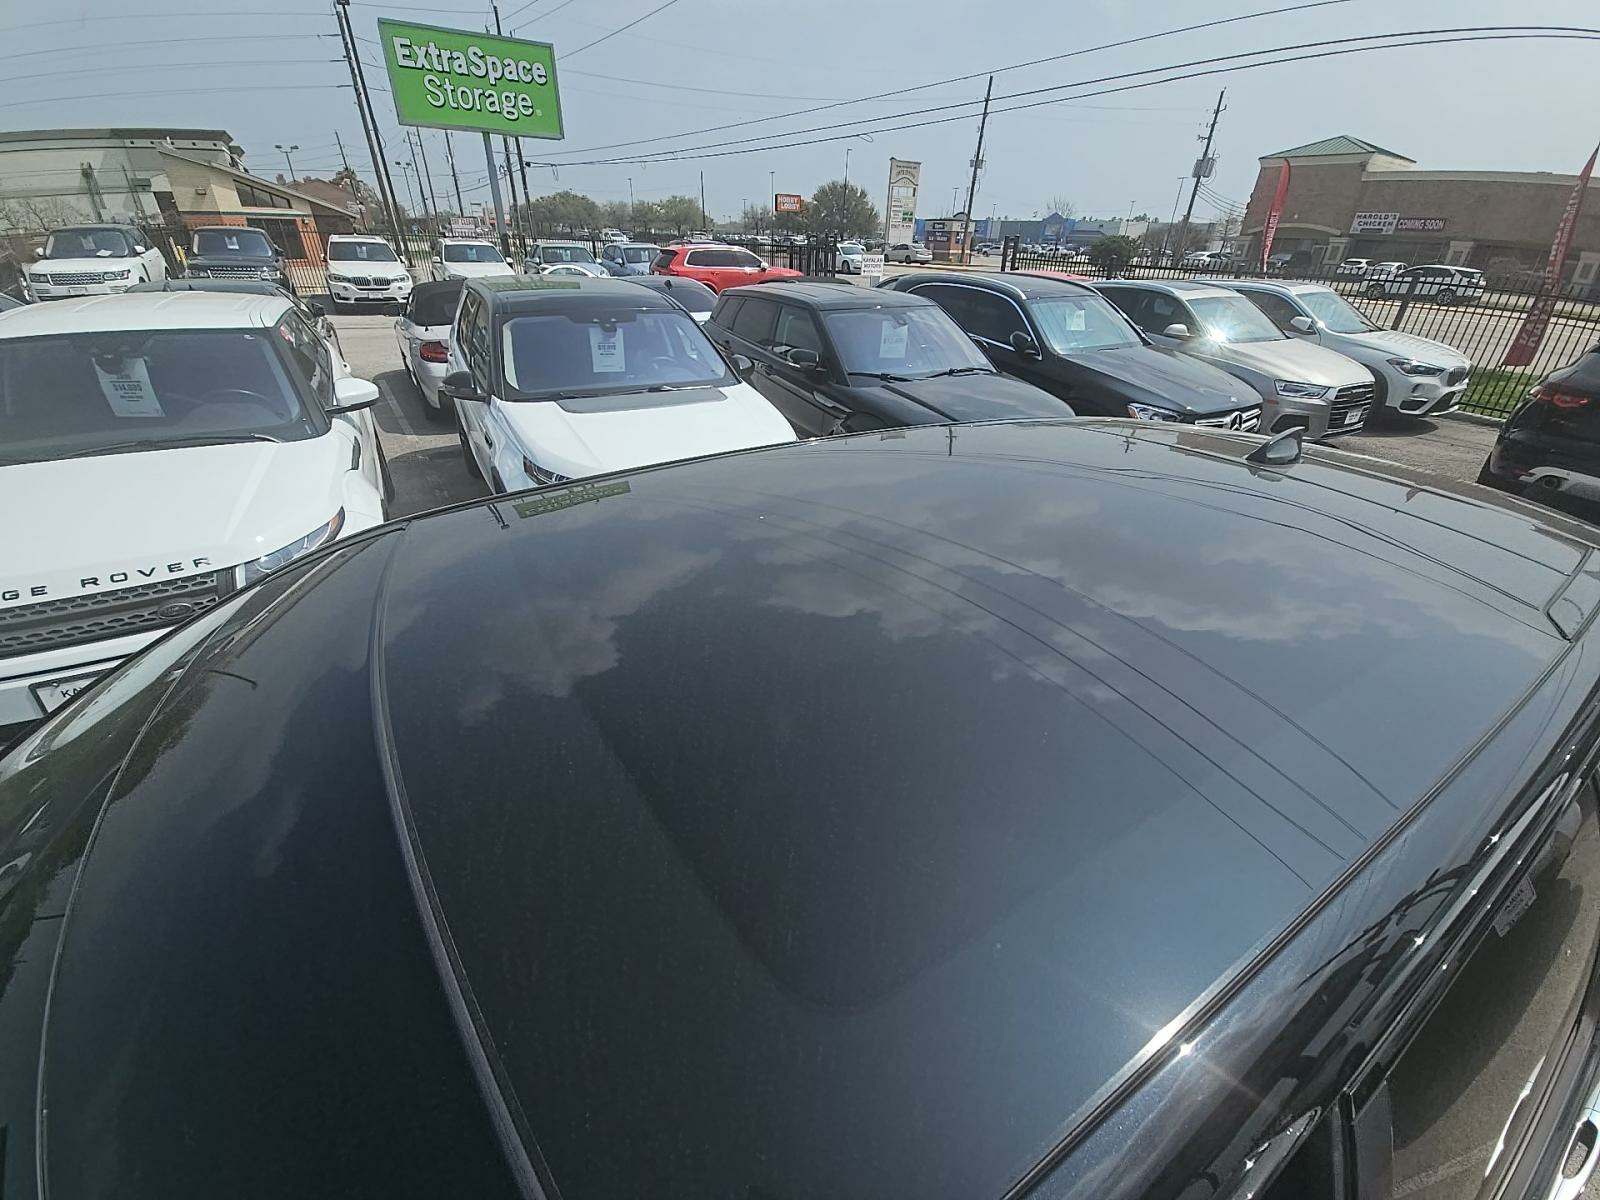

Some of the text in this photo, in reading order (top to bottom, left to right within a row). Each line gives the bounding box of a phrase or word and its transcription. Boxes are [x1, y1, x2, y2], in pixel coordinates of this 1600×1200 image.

[392, 36, 547, 85] ExtraSpace
[423, 74, 533, 120] Storage
[1398, 219, 1444, 230] COMING SOON
[80, 557, 212, 588] ROVER
